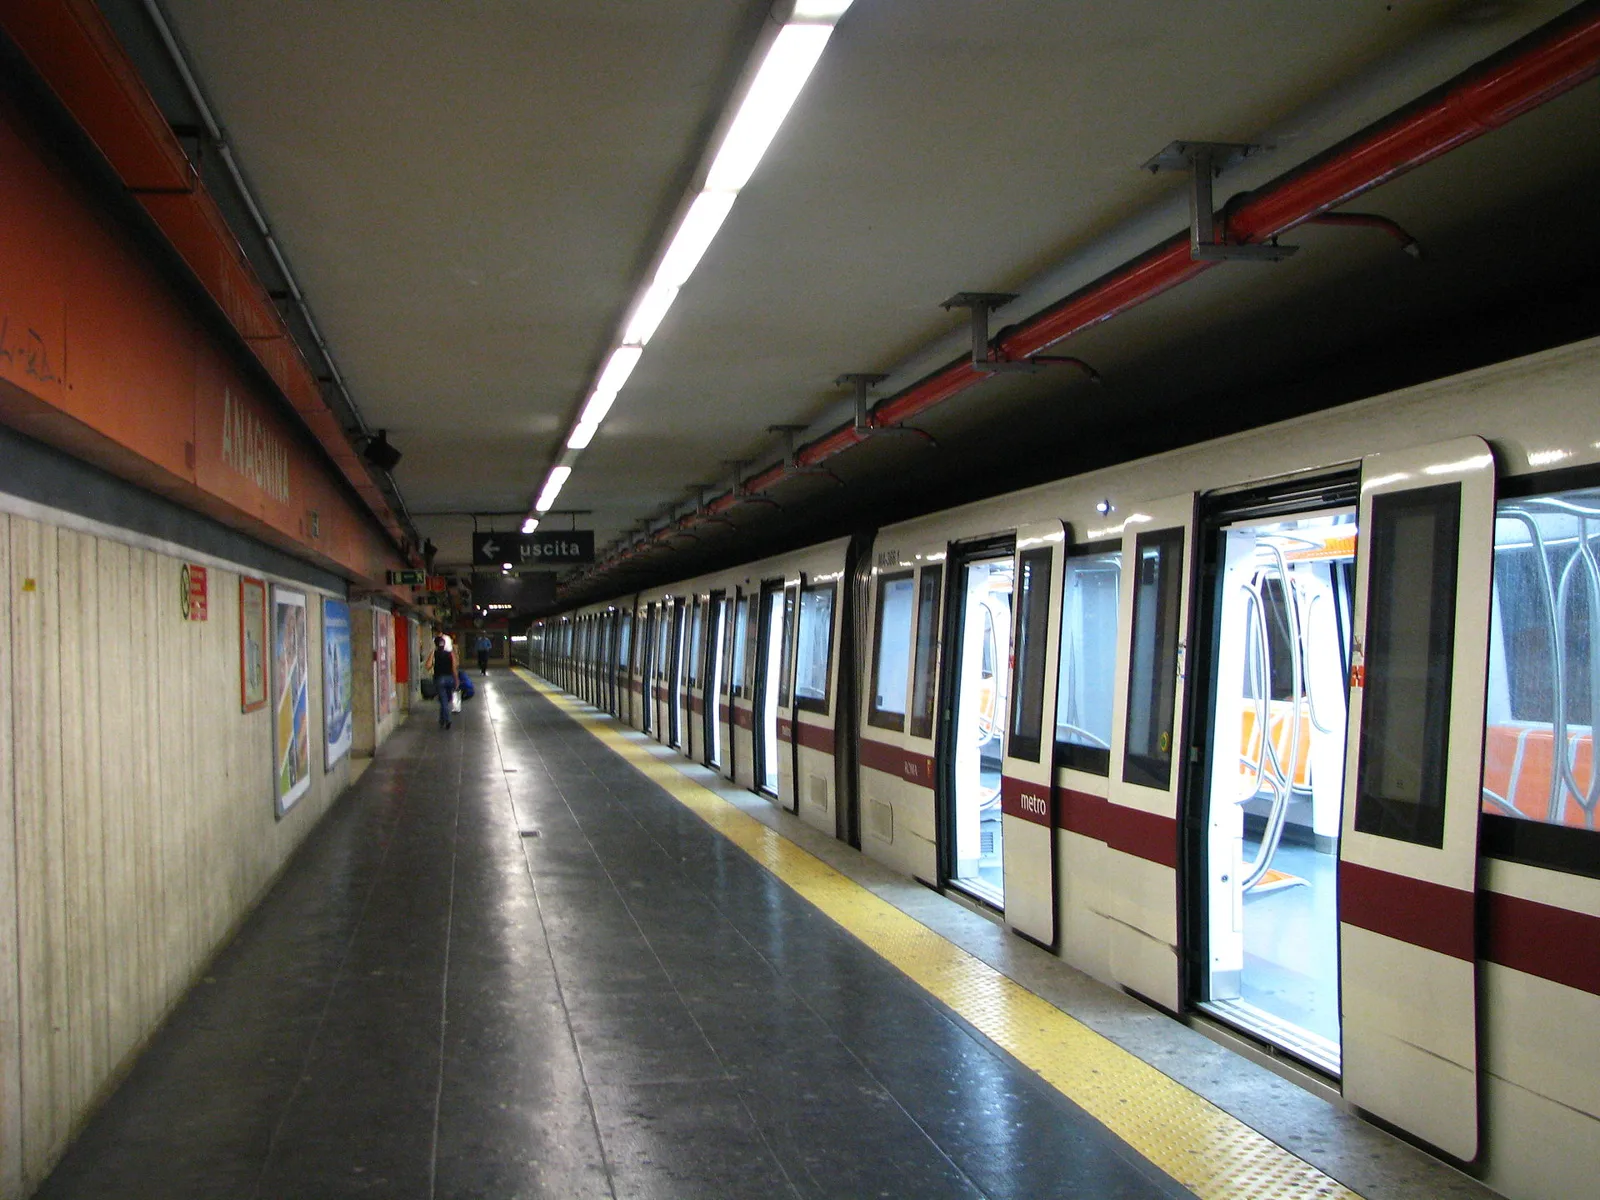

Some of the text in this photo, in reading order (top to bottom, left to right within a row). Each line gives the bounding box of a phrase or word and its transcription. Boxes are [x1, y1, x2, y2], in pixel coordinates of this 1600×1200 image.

[222, 384, 290, 508] ANAGNINA
[520, 540, 580, 557] uscita
[1020, 793, 1047, 816] metro
